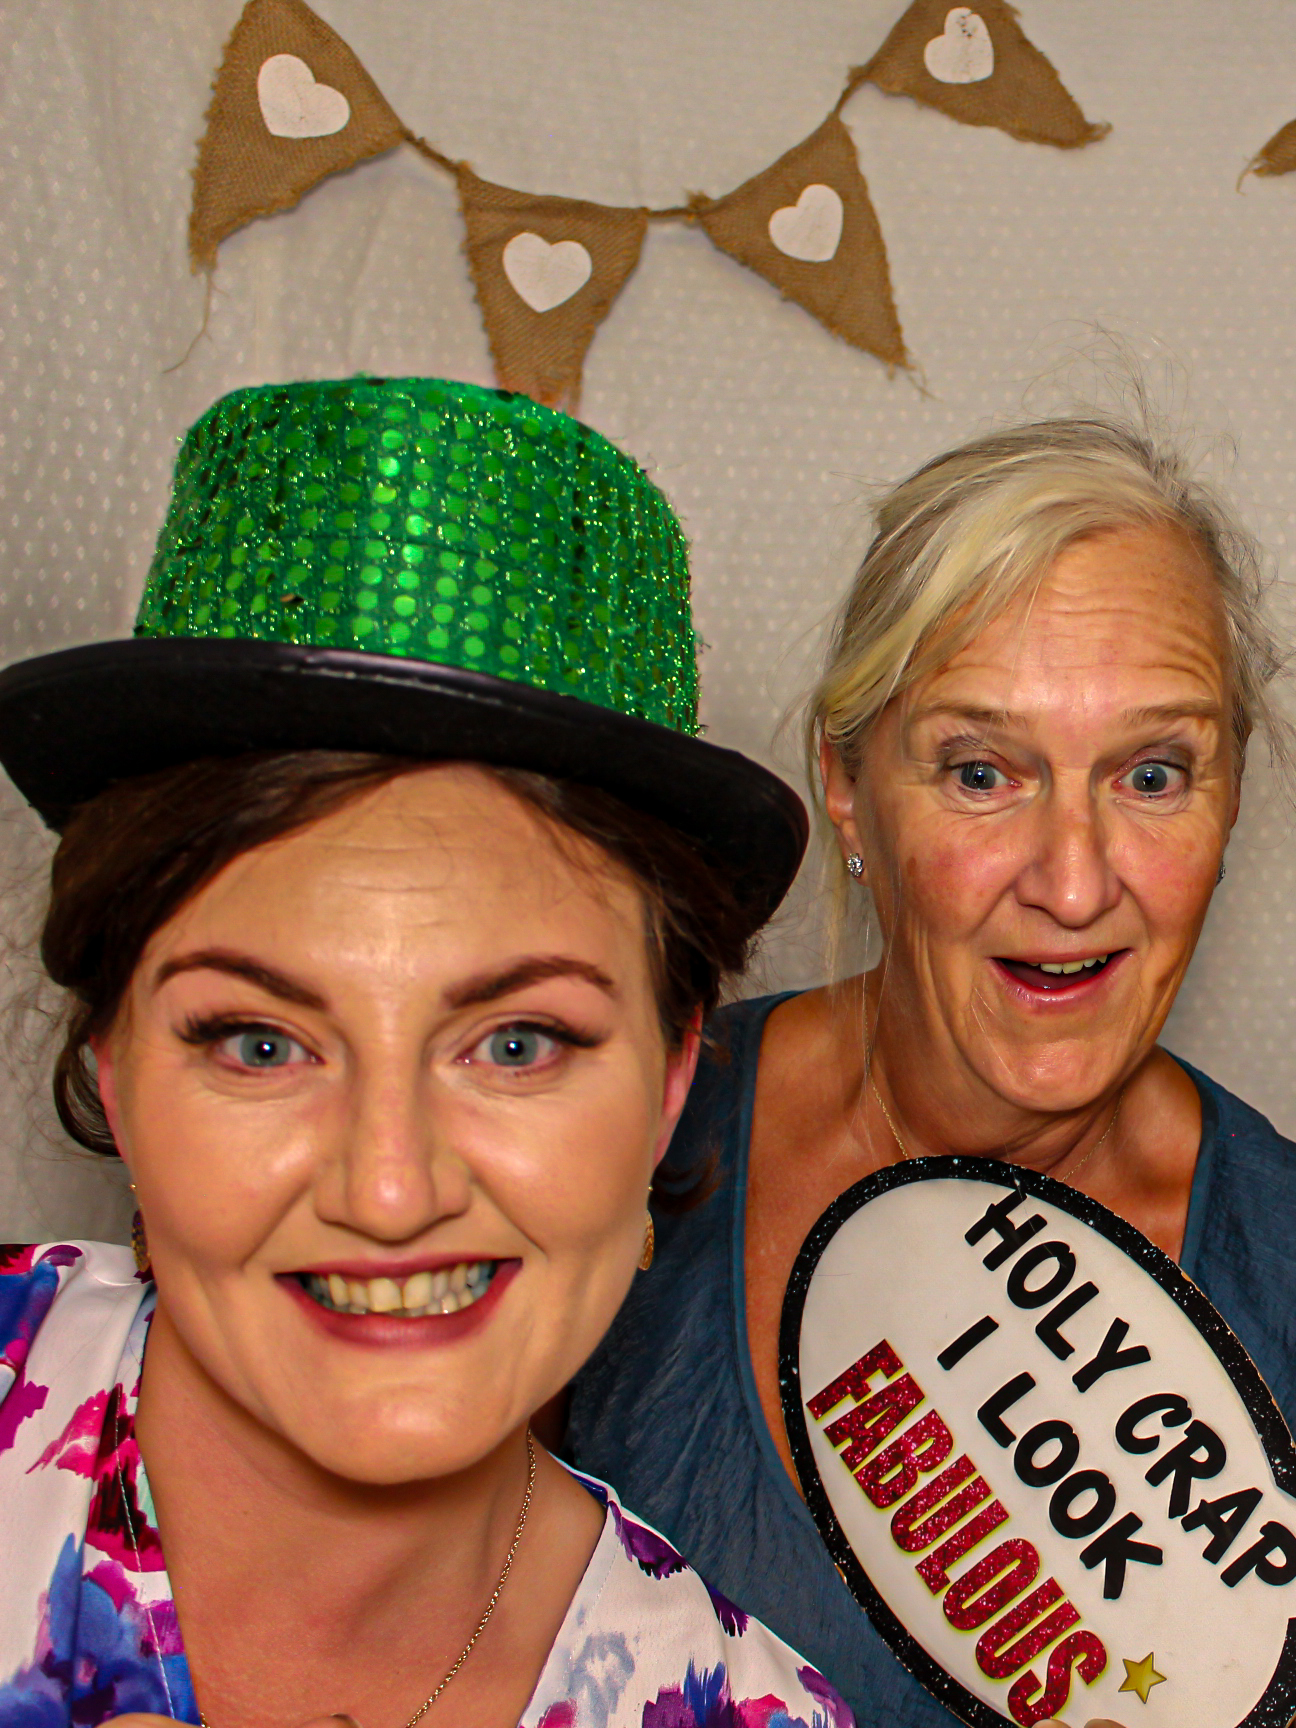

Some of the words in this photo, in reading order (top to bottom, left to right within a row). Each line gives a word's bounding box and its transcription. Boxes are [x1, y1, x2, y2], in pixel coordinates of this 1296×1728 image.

[964, 1190, 1151, 1393] HOLY
[805, 1338, 1108, 1728] FABULOUS
[937, 1315, 999, 1371] I
[977, 1371, 1163, 1600] LOOK
